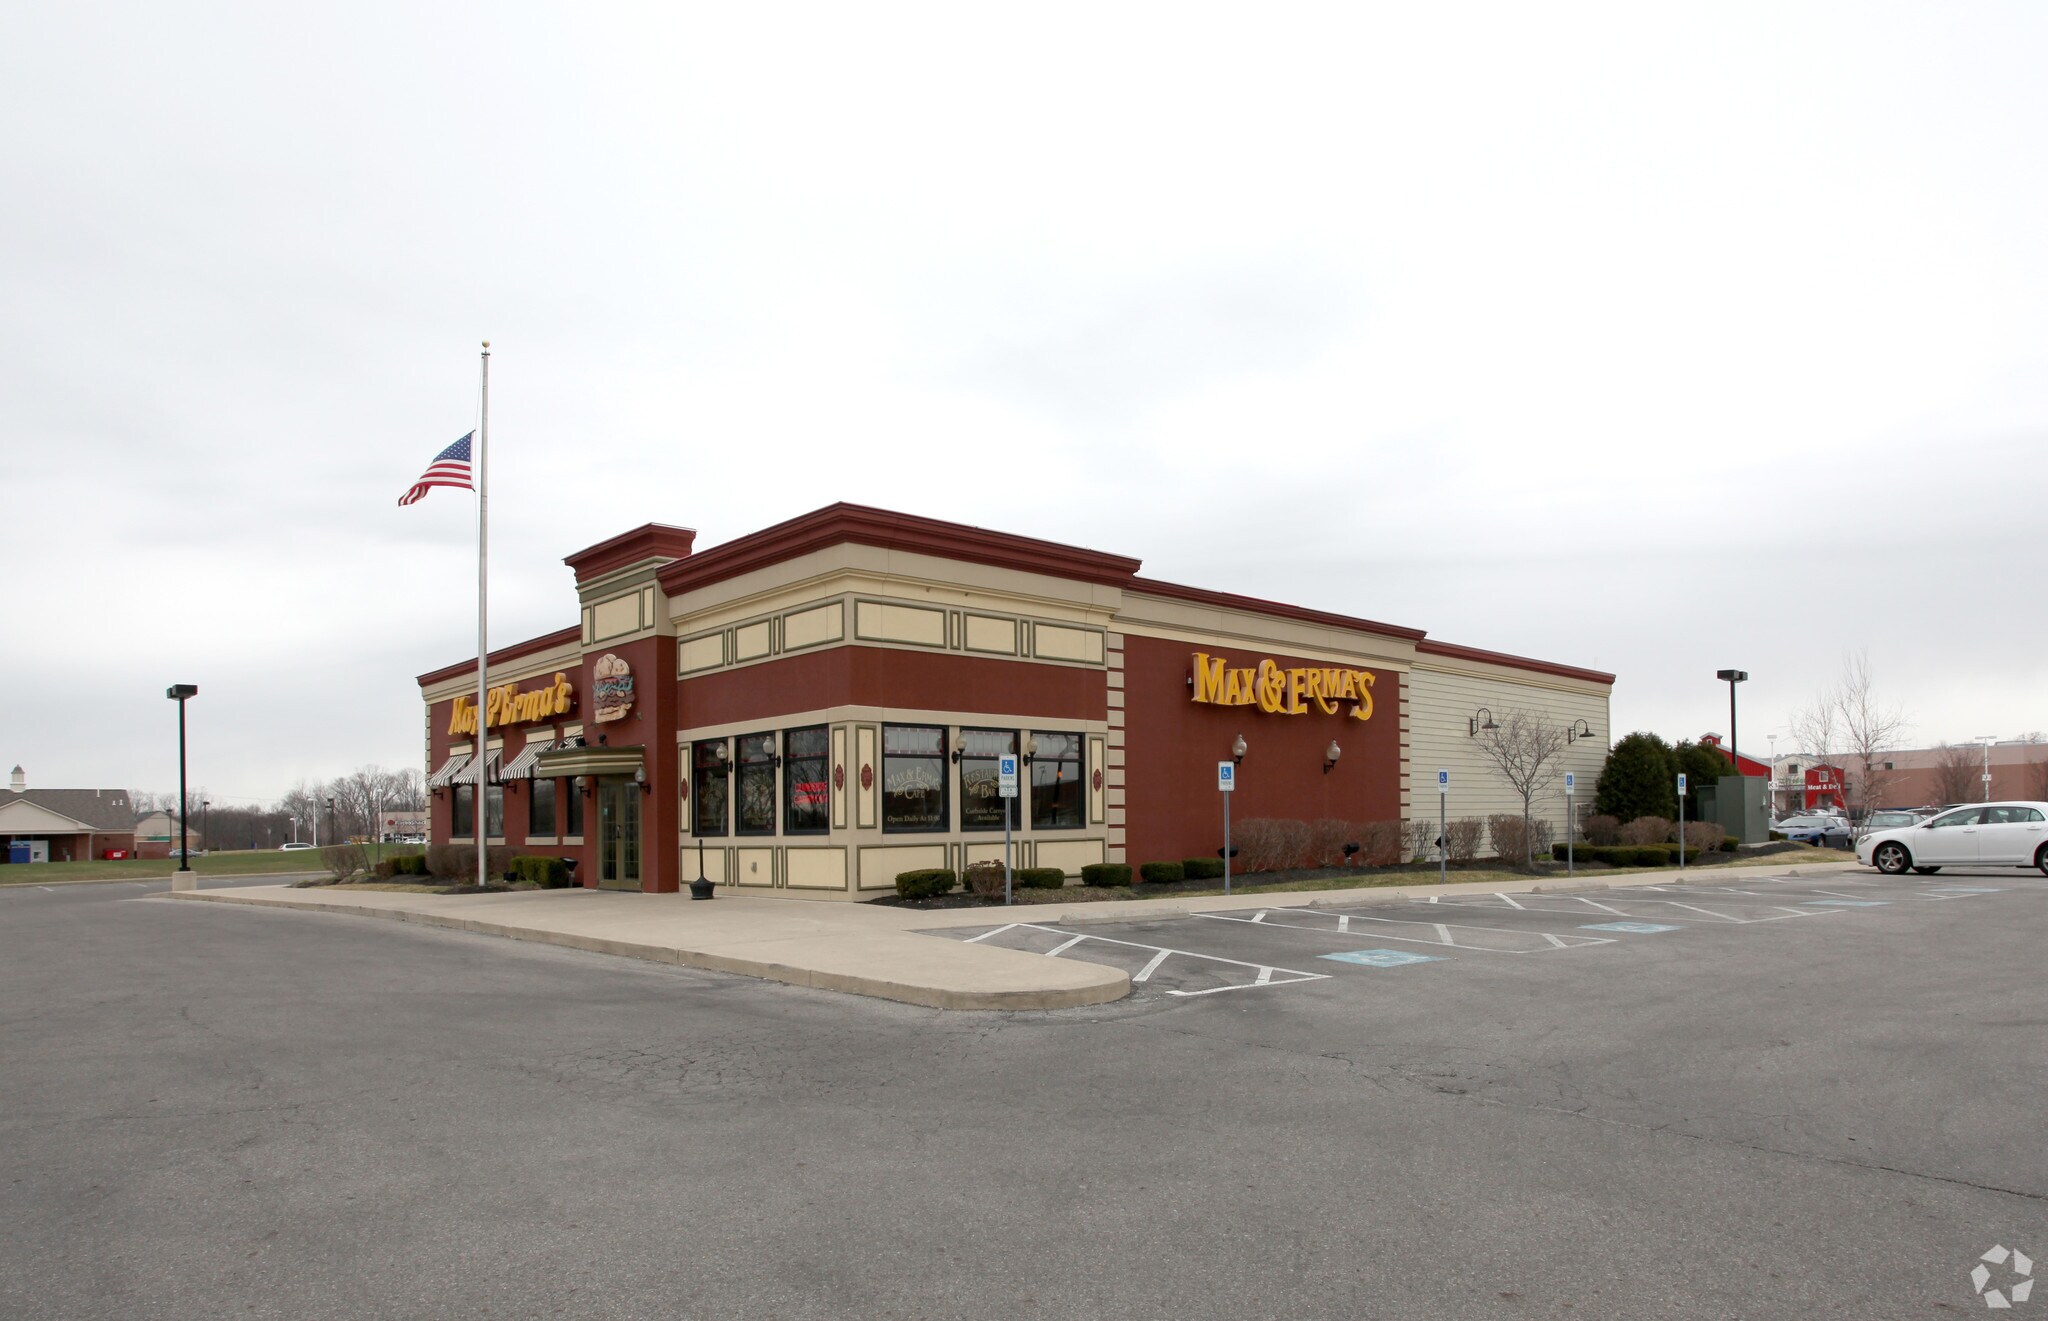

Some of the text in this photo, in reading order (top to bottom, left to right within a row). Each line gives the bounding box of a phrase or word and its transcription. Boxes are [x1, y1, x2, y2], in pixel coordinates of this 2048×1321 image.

[499, 672, 572, 725] Erma's
[1255, 658, 1288, 714] &
[964, 768, 999, 788] RESTAUR
[887, 815, 903, 824] Open
[904, 815, 919, 824] Daily
